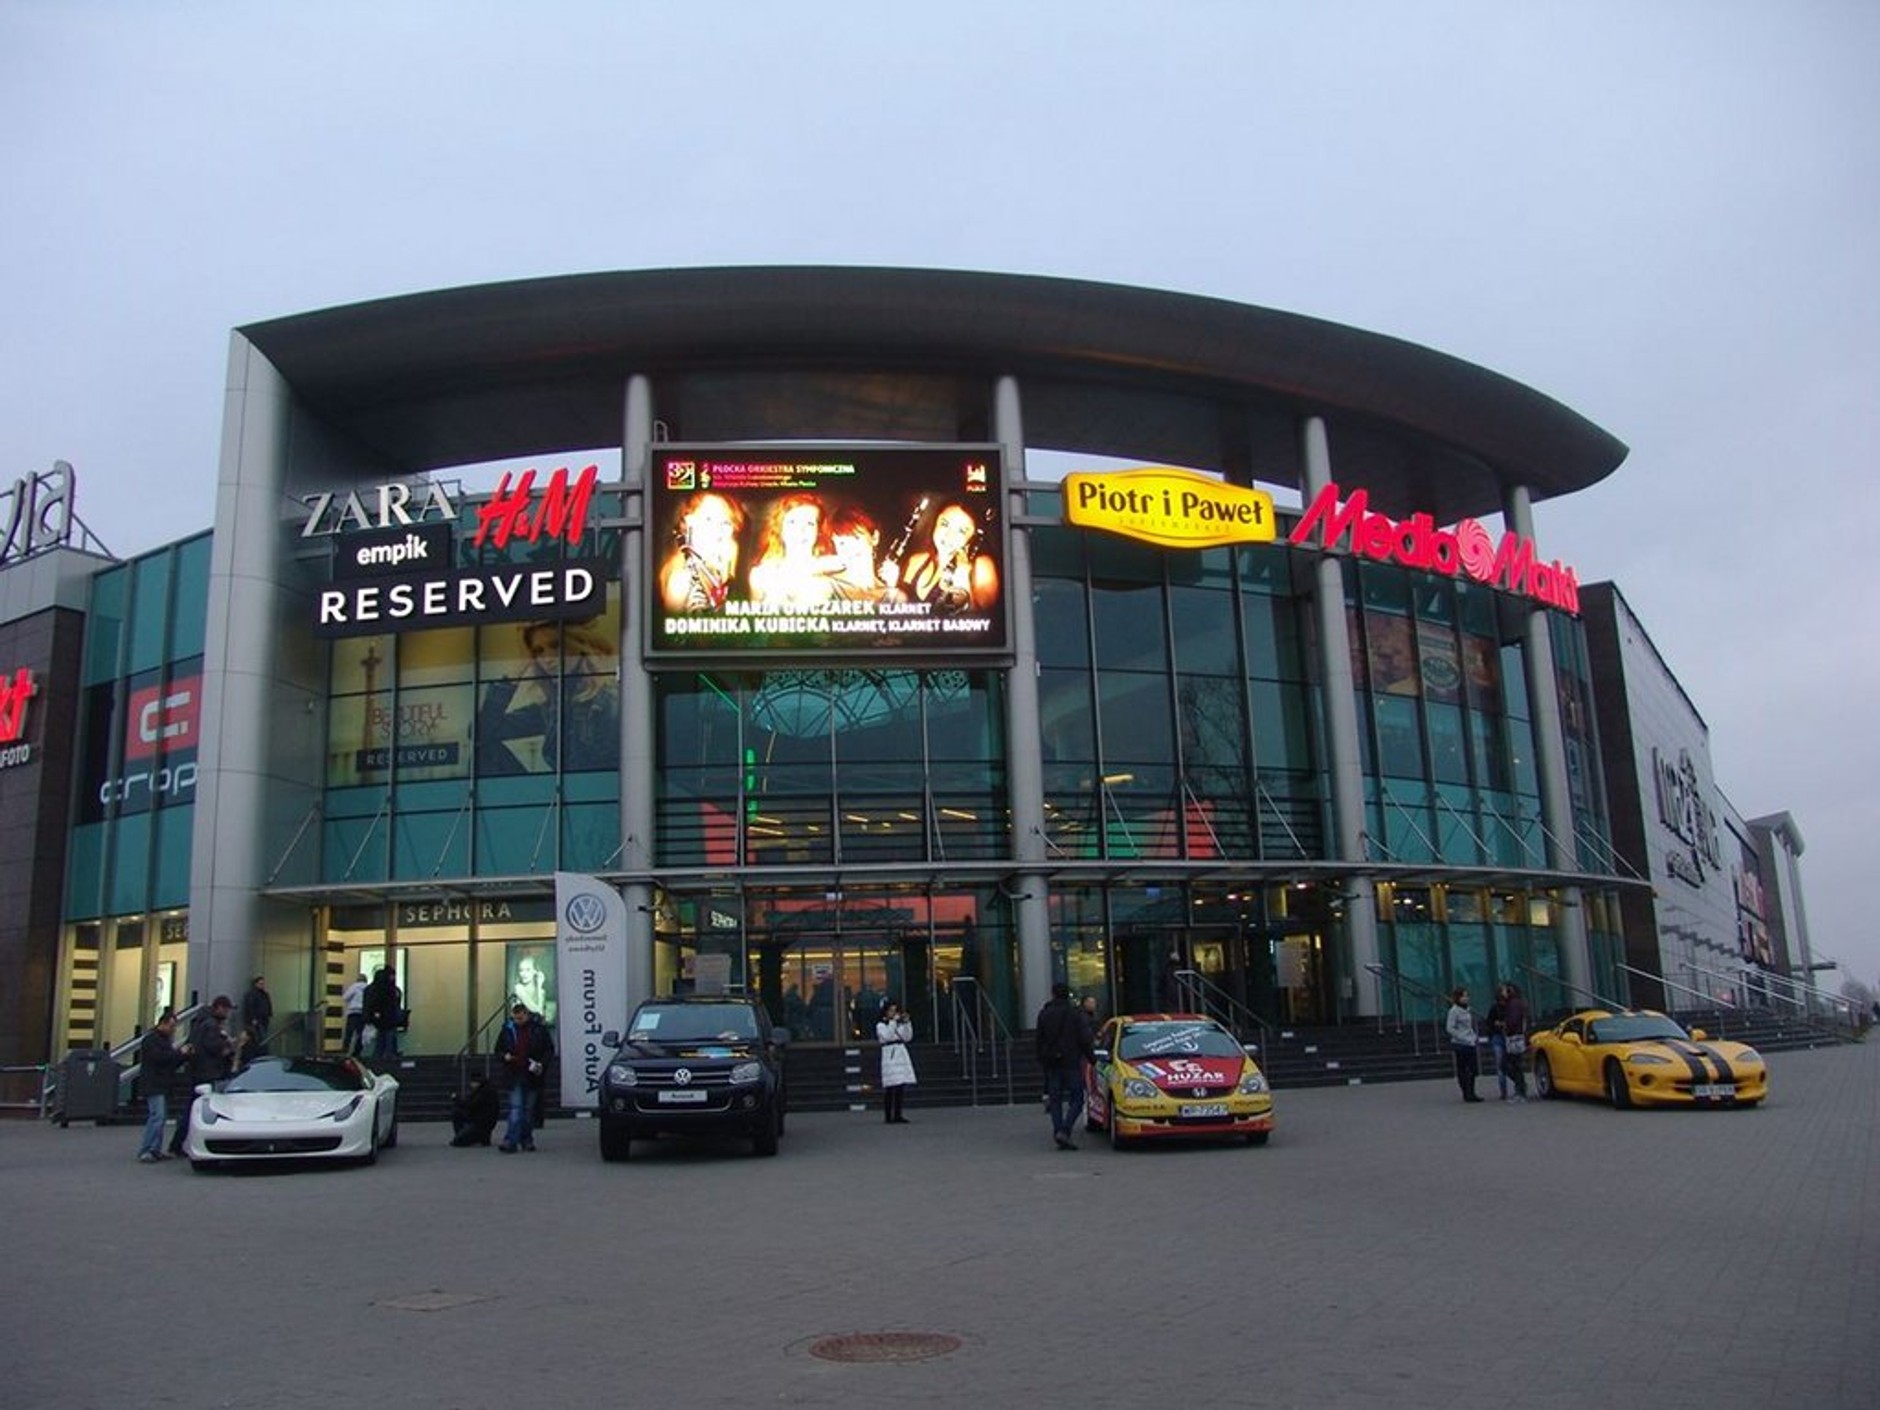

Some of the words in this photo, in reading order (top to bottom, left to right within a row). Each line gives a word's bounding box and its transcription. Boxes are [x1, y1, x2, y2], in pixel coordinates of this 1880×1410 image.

[301, 479, 459, 538] ZARA
[472, 464, 597, 549] H&M
[1079, 482, 1153, 515] Piotr
[1162, 490, 1172, 517] i
[356, 533, 428, 566] empik
[1289, 482, 1459, 575] Media
[1493, 530, 1581, 614] Markt
[320, 567, 593, 625] RESERVED
[879, 603, 932, 615] KLARNET
[665, 617, 751, 634] DOMINIKA
[754, 617, 830, 634] KUBICKA
[888, 619, 941, 632] KLARNET
[943, 619, 990, 632] BASOWY
[99, 762, 198, 804] crop
